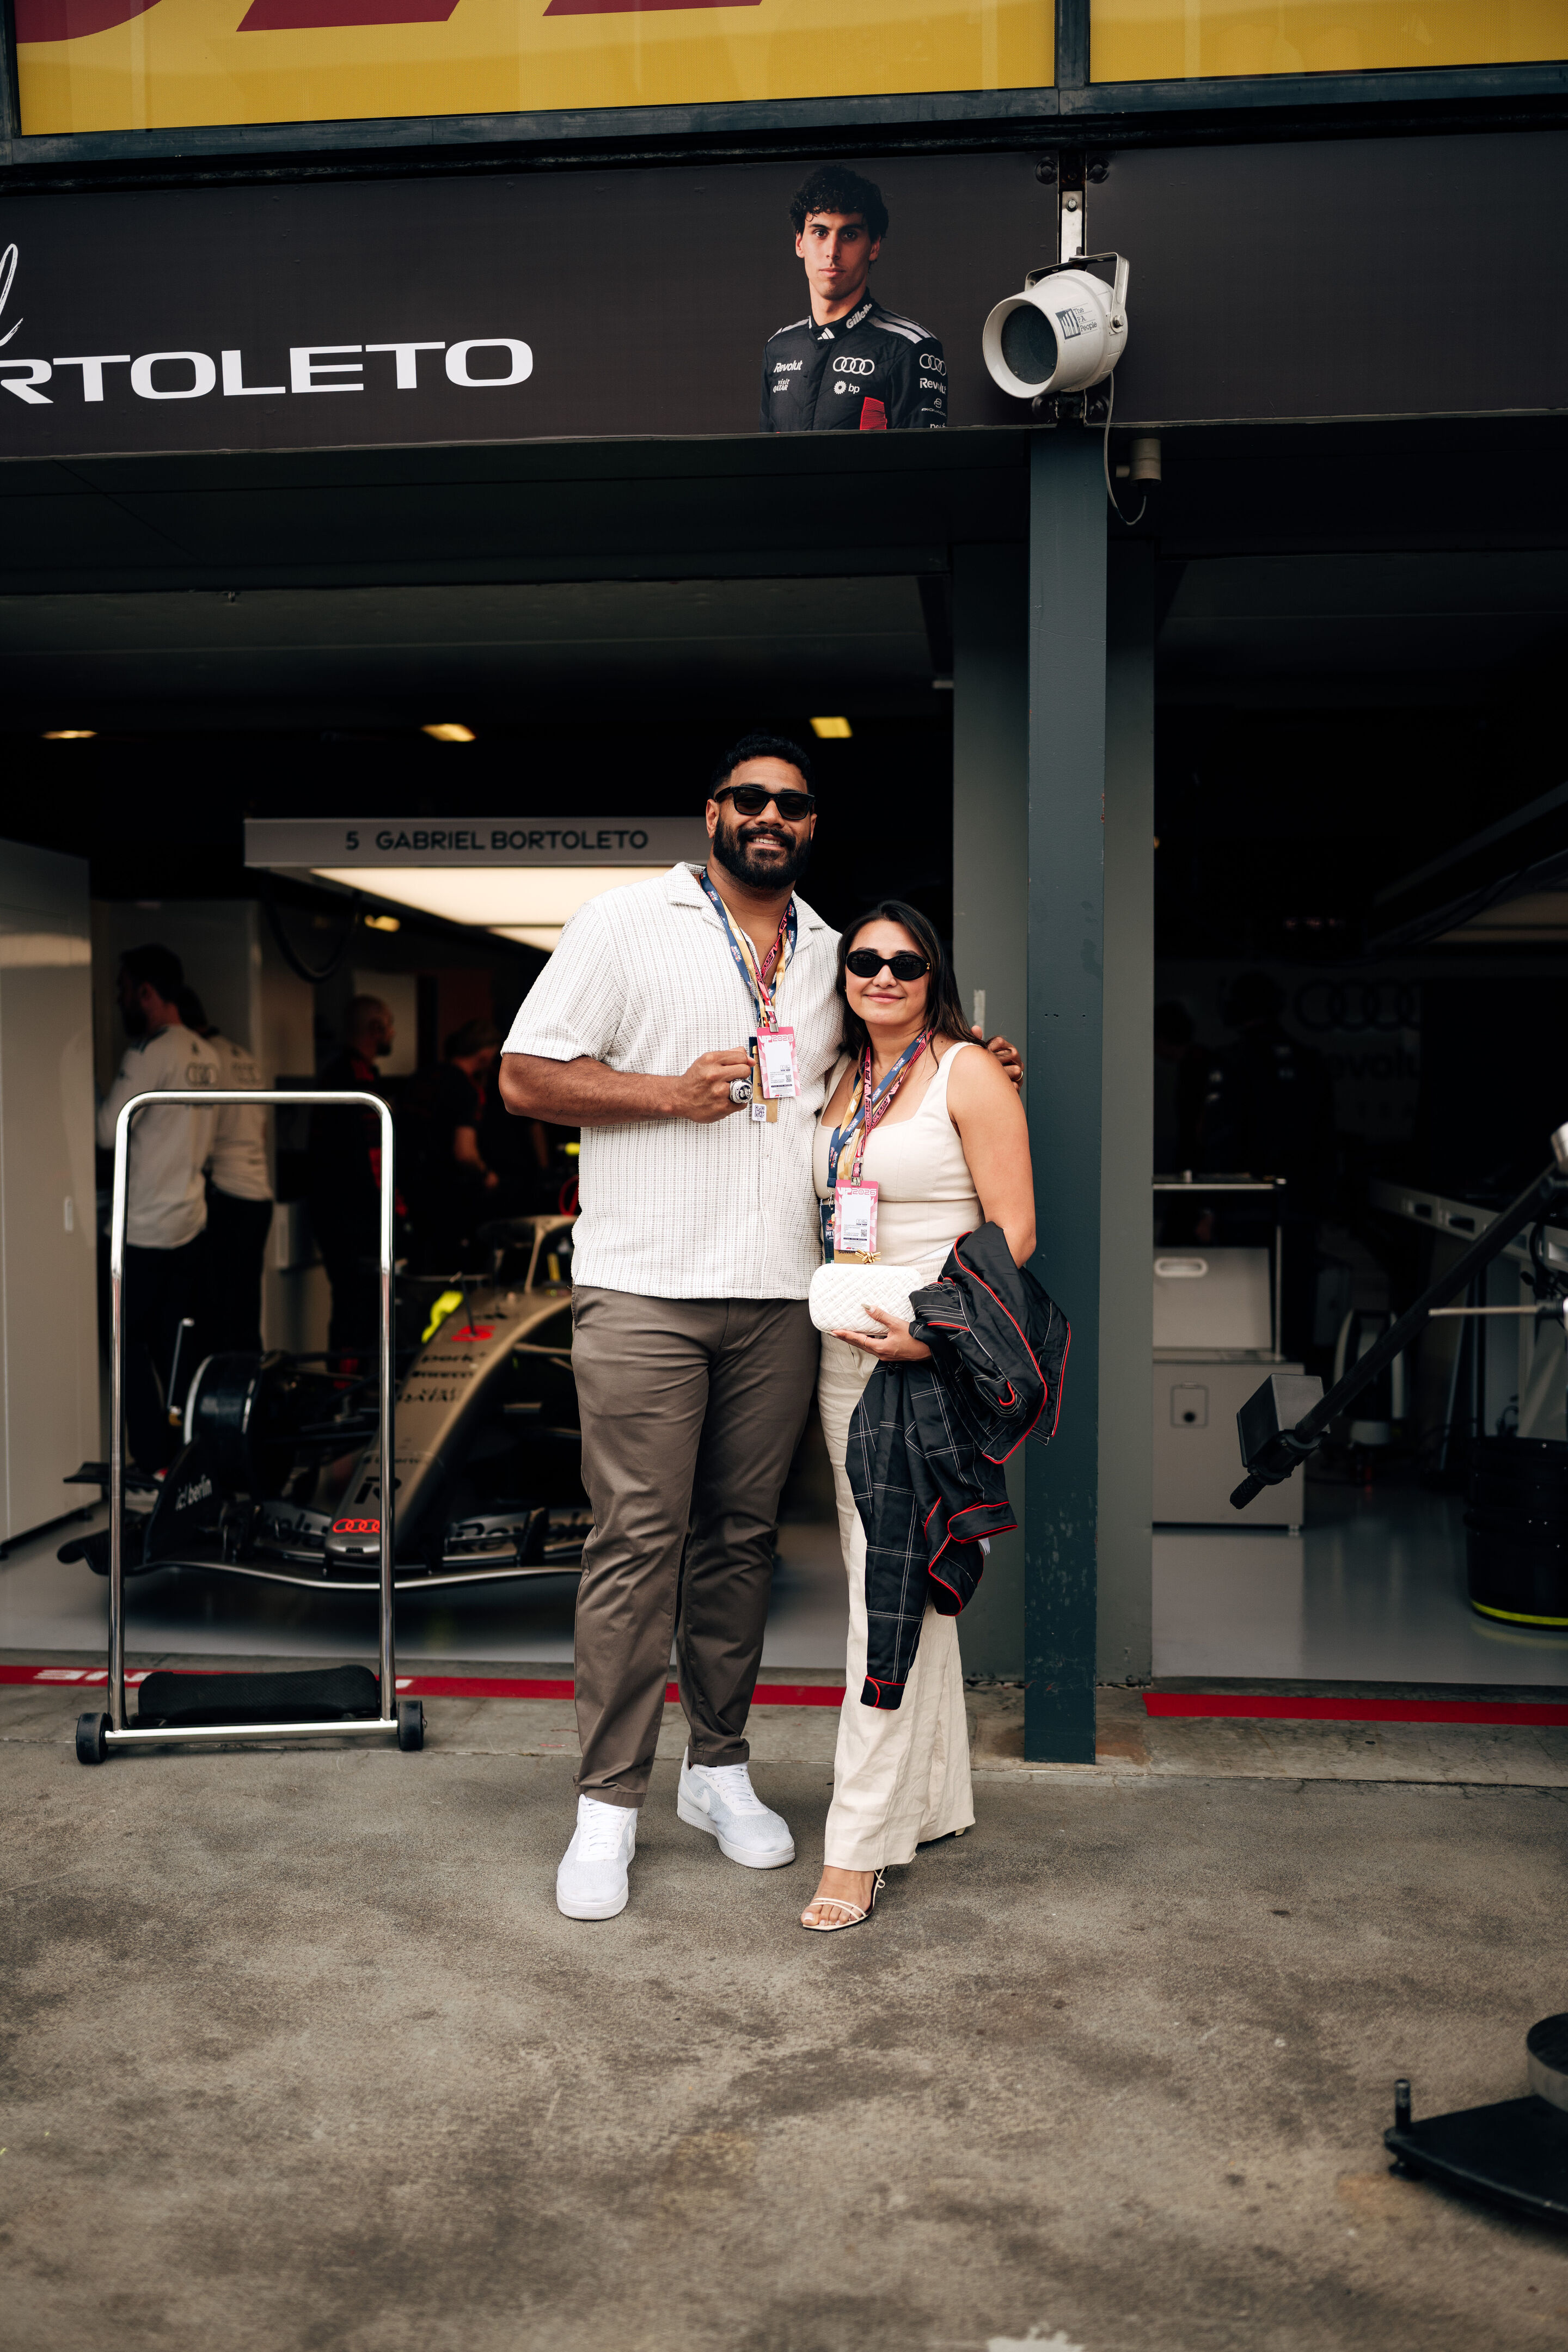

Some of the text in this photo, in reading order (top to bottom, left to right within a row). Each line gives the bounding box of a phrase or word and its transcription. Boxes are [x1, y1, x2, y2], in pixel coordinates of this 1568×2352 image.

[1080, 321, 1097, 332] People
[0, 338, 534, 404] RTOLETO
[773, 360, 803, 373] Revolut
[773, 384, 789, 393] QATAR
[848, 383, 860, 394] bp
[346, 830, 649, 850] 5 GABRIEL BORTOLETO
